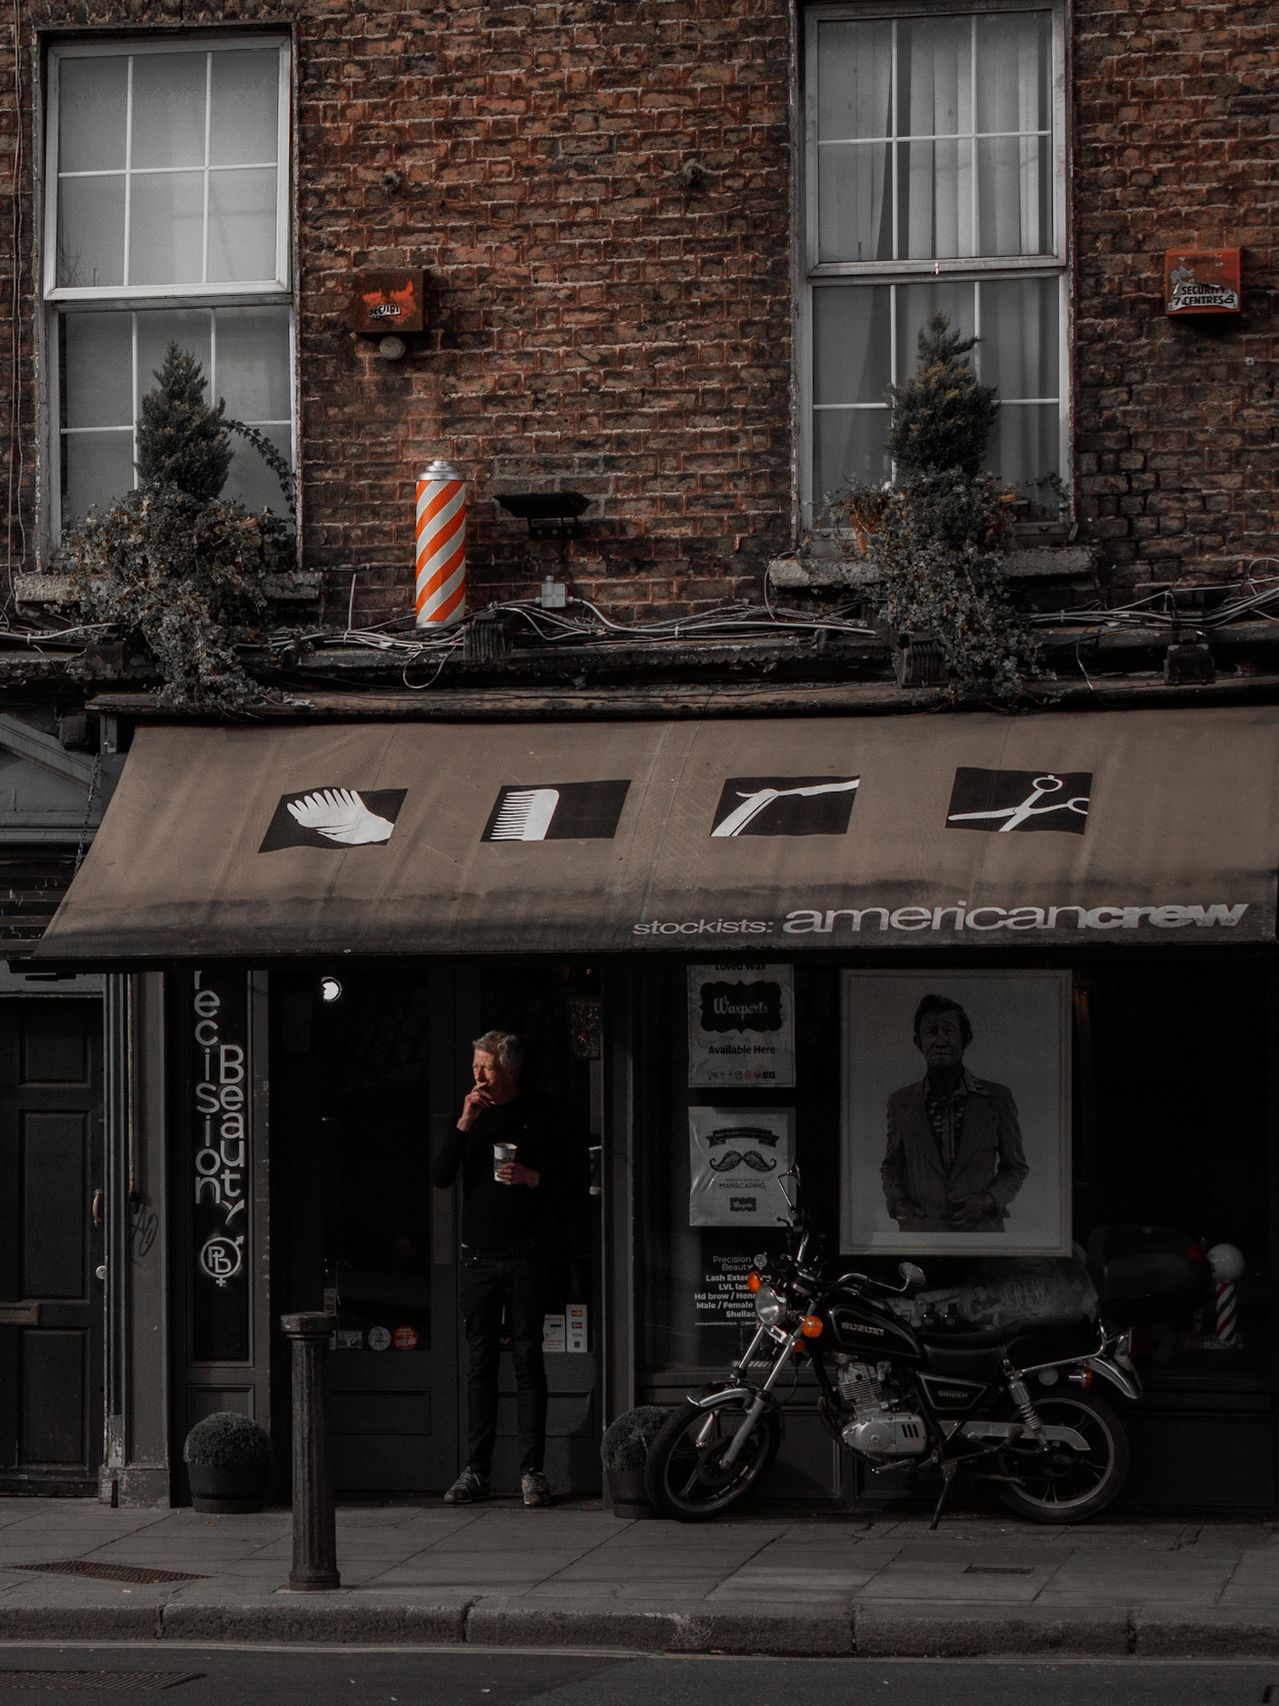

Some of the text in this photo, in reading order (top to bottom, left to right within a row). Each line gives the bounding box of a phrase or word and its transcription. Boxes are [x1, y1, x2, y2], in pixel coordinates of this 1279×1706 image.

[632, 917, 774, 936] stockists:
[713, 992, 769, 1020] Waxperts
[709, 1045, 776, 1054] Available Here
[194, 970, 221, 1204] recision
[712, 1255, 752, 1264] Precision
[721, 1264, 754, 1272] Beauty
[705, 1274, 726, 1282] Lash
[718, 1283, 750, 1291] LVL las
[694, 1292, 707, 1300] Hd
[708, 1292, 729, 1300] brow
[696, 1301, 716, 1309] Male
[723, 1301, 753, 1309] Female
